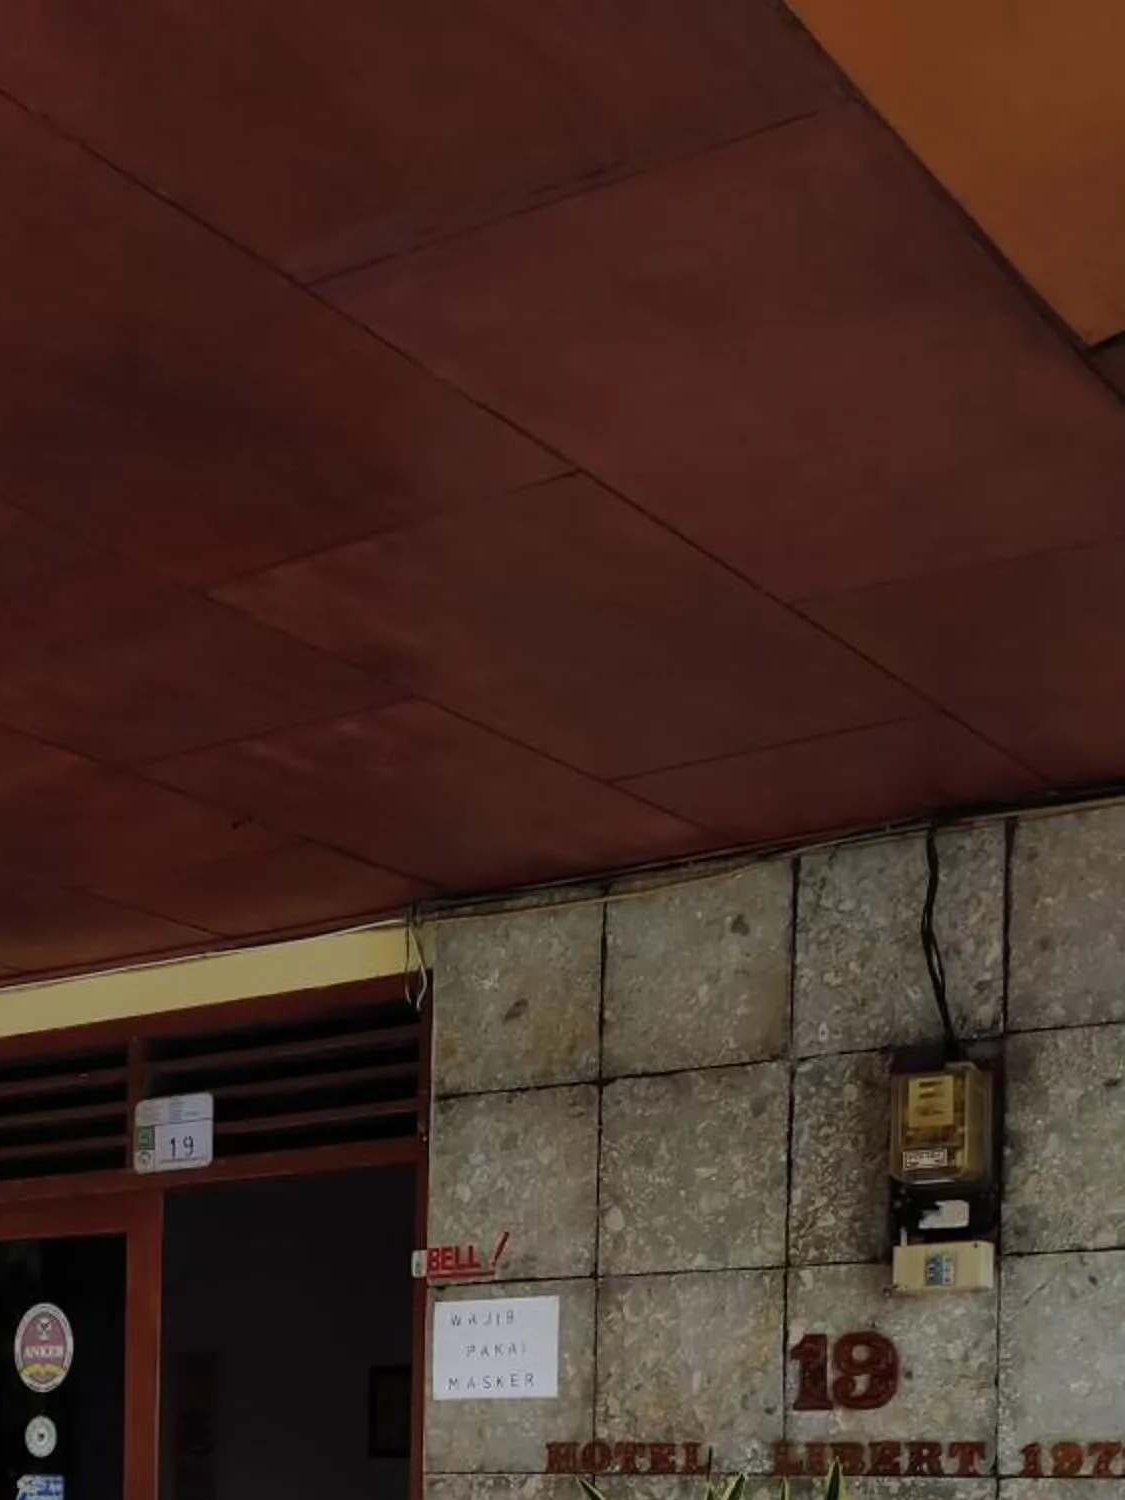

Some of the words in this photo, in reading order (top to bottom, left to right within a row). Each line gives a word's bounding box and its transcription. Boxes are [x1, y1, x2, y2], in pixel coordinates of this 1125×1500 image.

[170, 1135, 194, 1158] 19
[450, 1309, 515, 1327] WAJIB
[448, 1373, 535, 1391] MASKER
[789, 1331, 900, 1411] 19
[545, 1441, 711, 1474] HOTEL
[1020, 1442, 1125, 1477] 197
